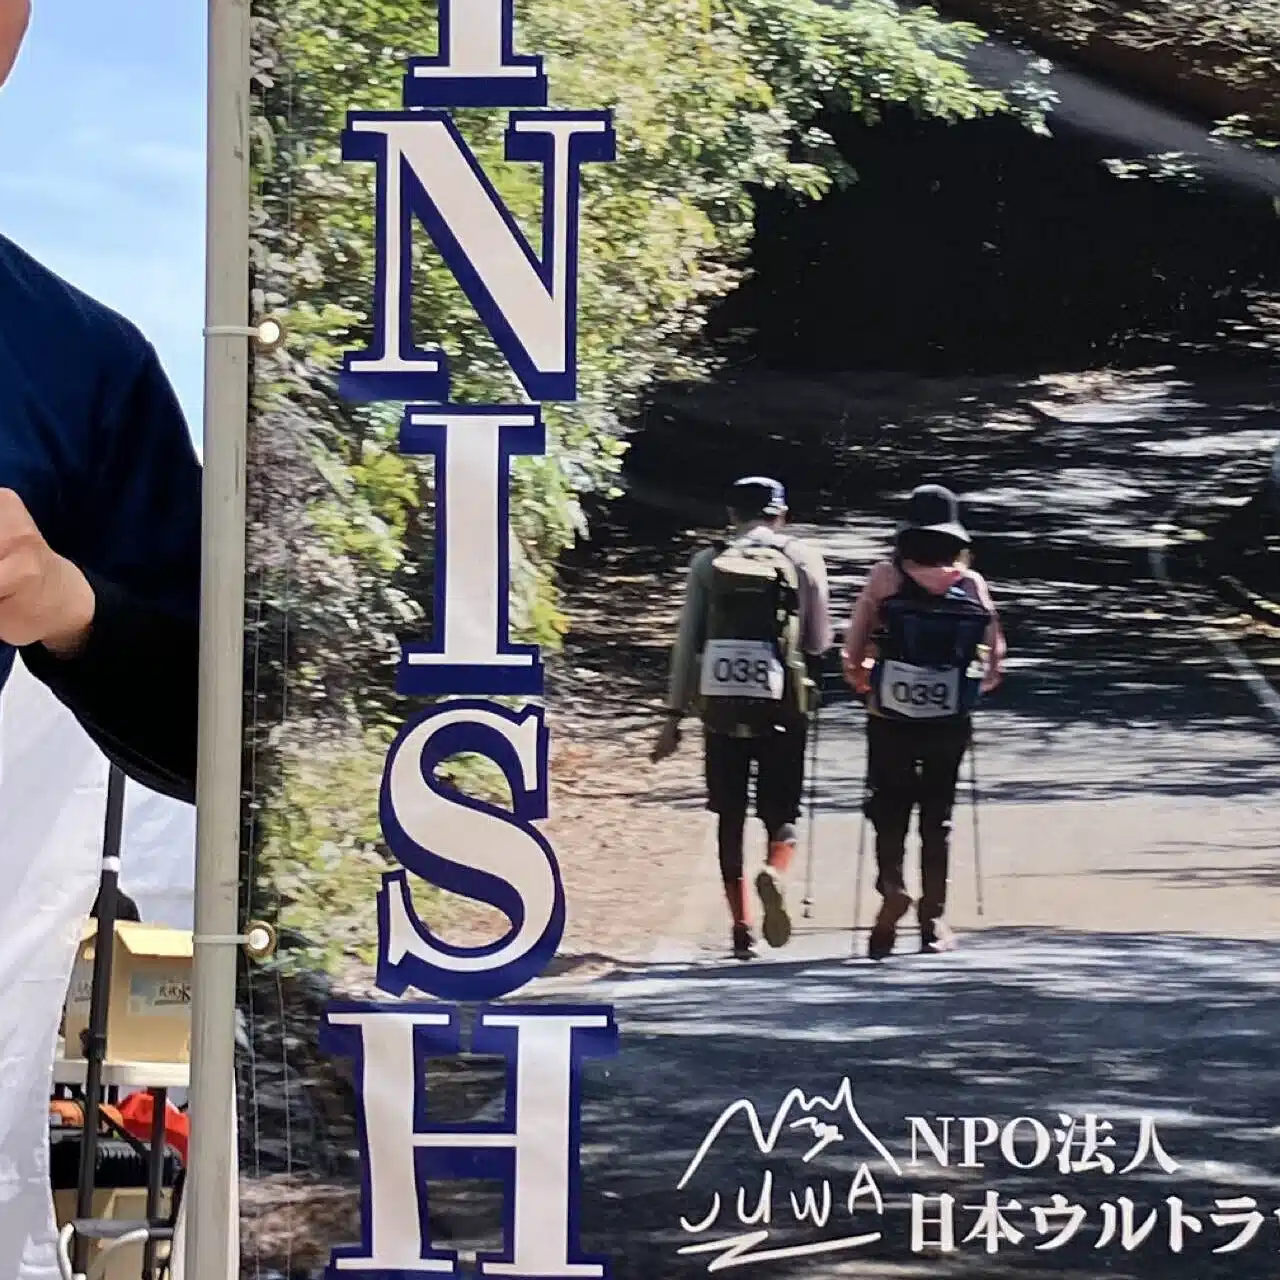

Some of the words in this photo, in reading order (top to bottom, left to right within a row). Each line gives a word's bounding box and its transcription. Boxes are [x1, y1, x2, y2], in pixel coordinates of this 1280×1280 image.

[714, 657, 769, 683] 038
[892, 681, 948, 706] 039
[904, 1112, 1180, 1176] NPO法人
